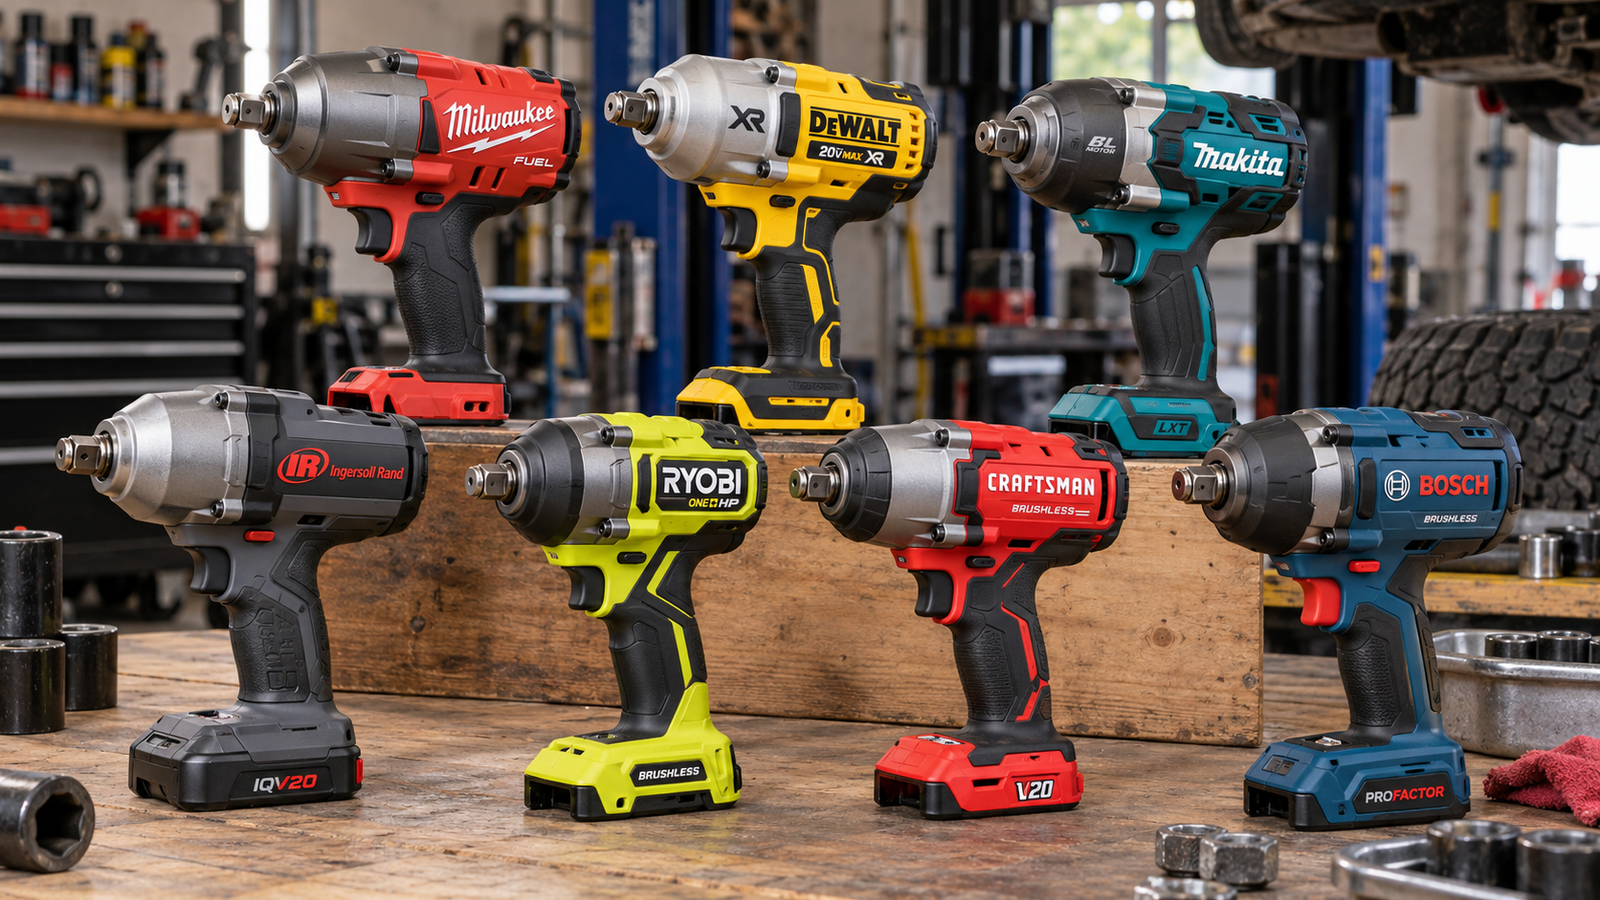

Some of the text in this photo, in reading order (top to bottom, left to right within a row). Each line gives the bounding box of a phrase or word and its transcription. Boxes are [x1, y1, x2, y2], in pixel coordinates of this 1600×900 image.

[442, 100, 556, 141] Milwaukee
[727, 104, 766, 134] XR
[1085, 146, 1116, 155] MOTOR
[1088, 135, 1118, 149] BL
[513, 156, 554, 168] FUEL
[864, 150, 885, 166] XR
[1192, 141, 1285, 177] Makita
[1158, 422, 1188, 434] LXT
[285, 453, 405, 481] IR Ingersoll Rand
[662, 466, 742, 495] RYOBI
[987, 472, 1095, 496] CRAFTSMAN
[1419, 474, 1489, 496] BOSCH
[1011, 504, 1075, 516] BRUSHLESS
[1423, 514, 1479, 524] BRUSHLESS
[638, 766, 700, 781] BRUSHLESS
[252, 774, 318, 794] IQV20
[1015, 779, 1055, 801] V20
[1365, 785, 1445, 804] PROFACTOR
